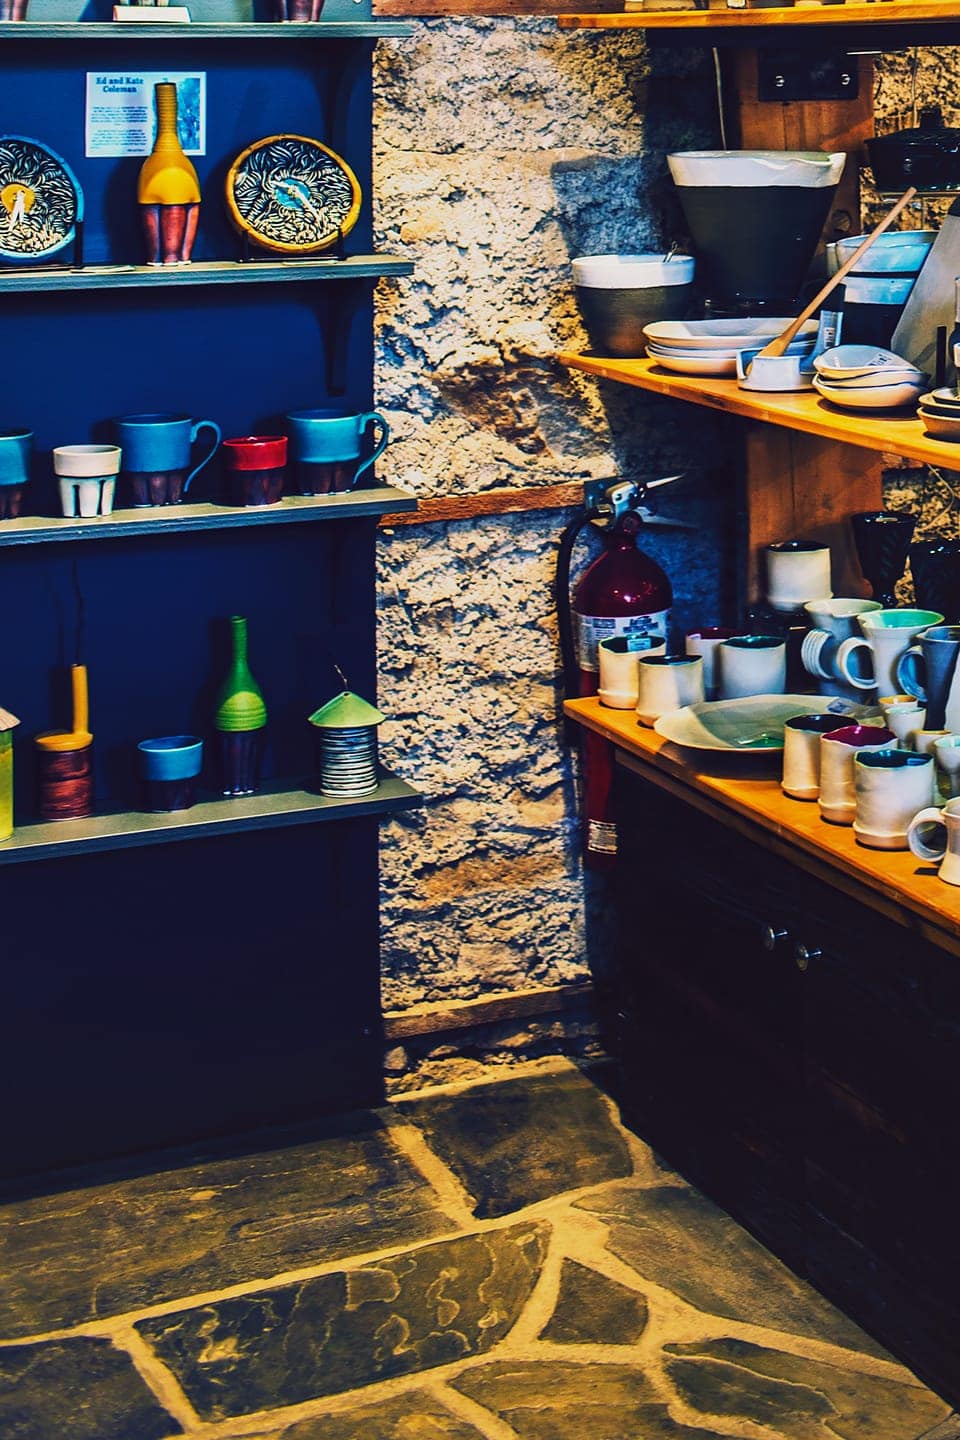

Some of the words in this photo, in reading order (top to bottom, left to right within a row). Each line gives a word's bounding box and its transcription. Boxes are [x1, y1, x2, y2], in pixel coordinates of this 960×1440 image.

[96, 77, 107, 85] Ed
[109, 77, 124, 85] and
[126, 77, 144, 85] Kate
[103, 85, 137, 93] Coleman
